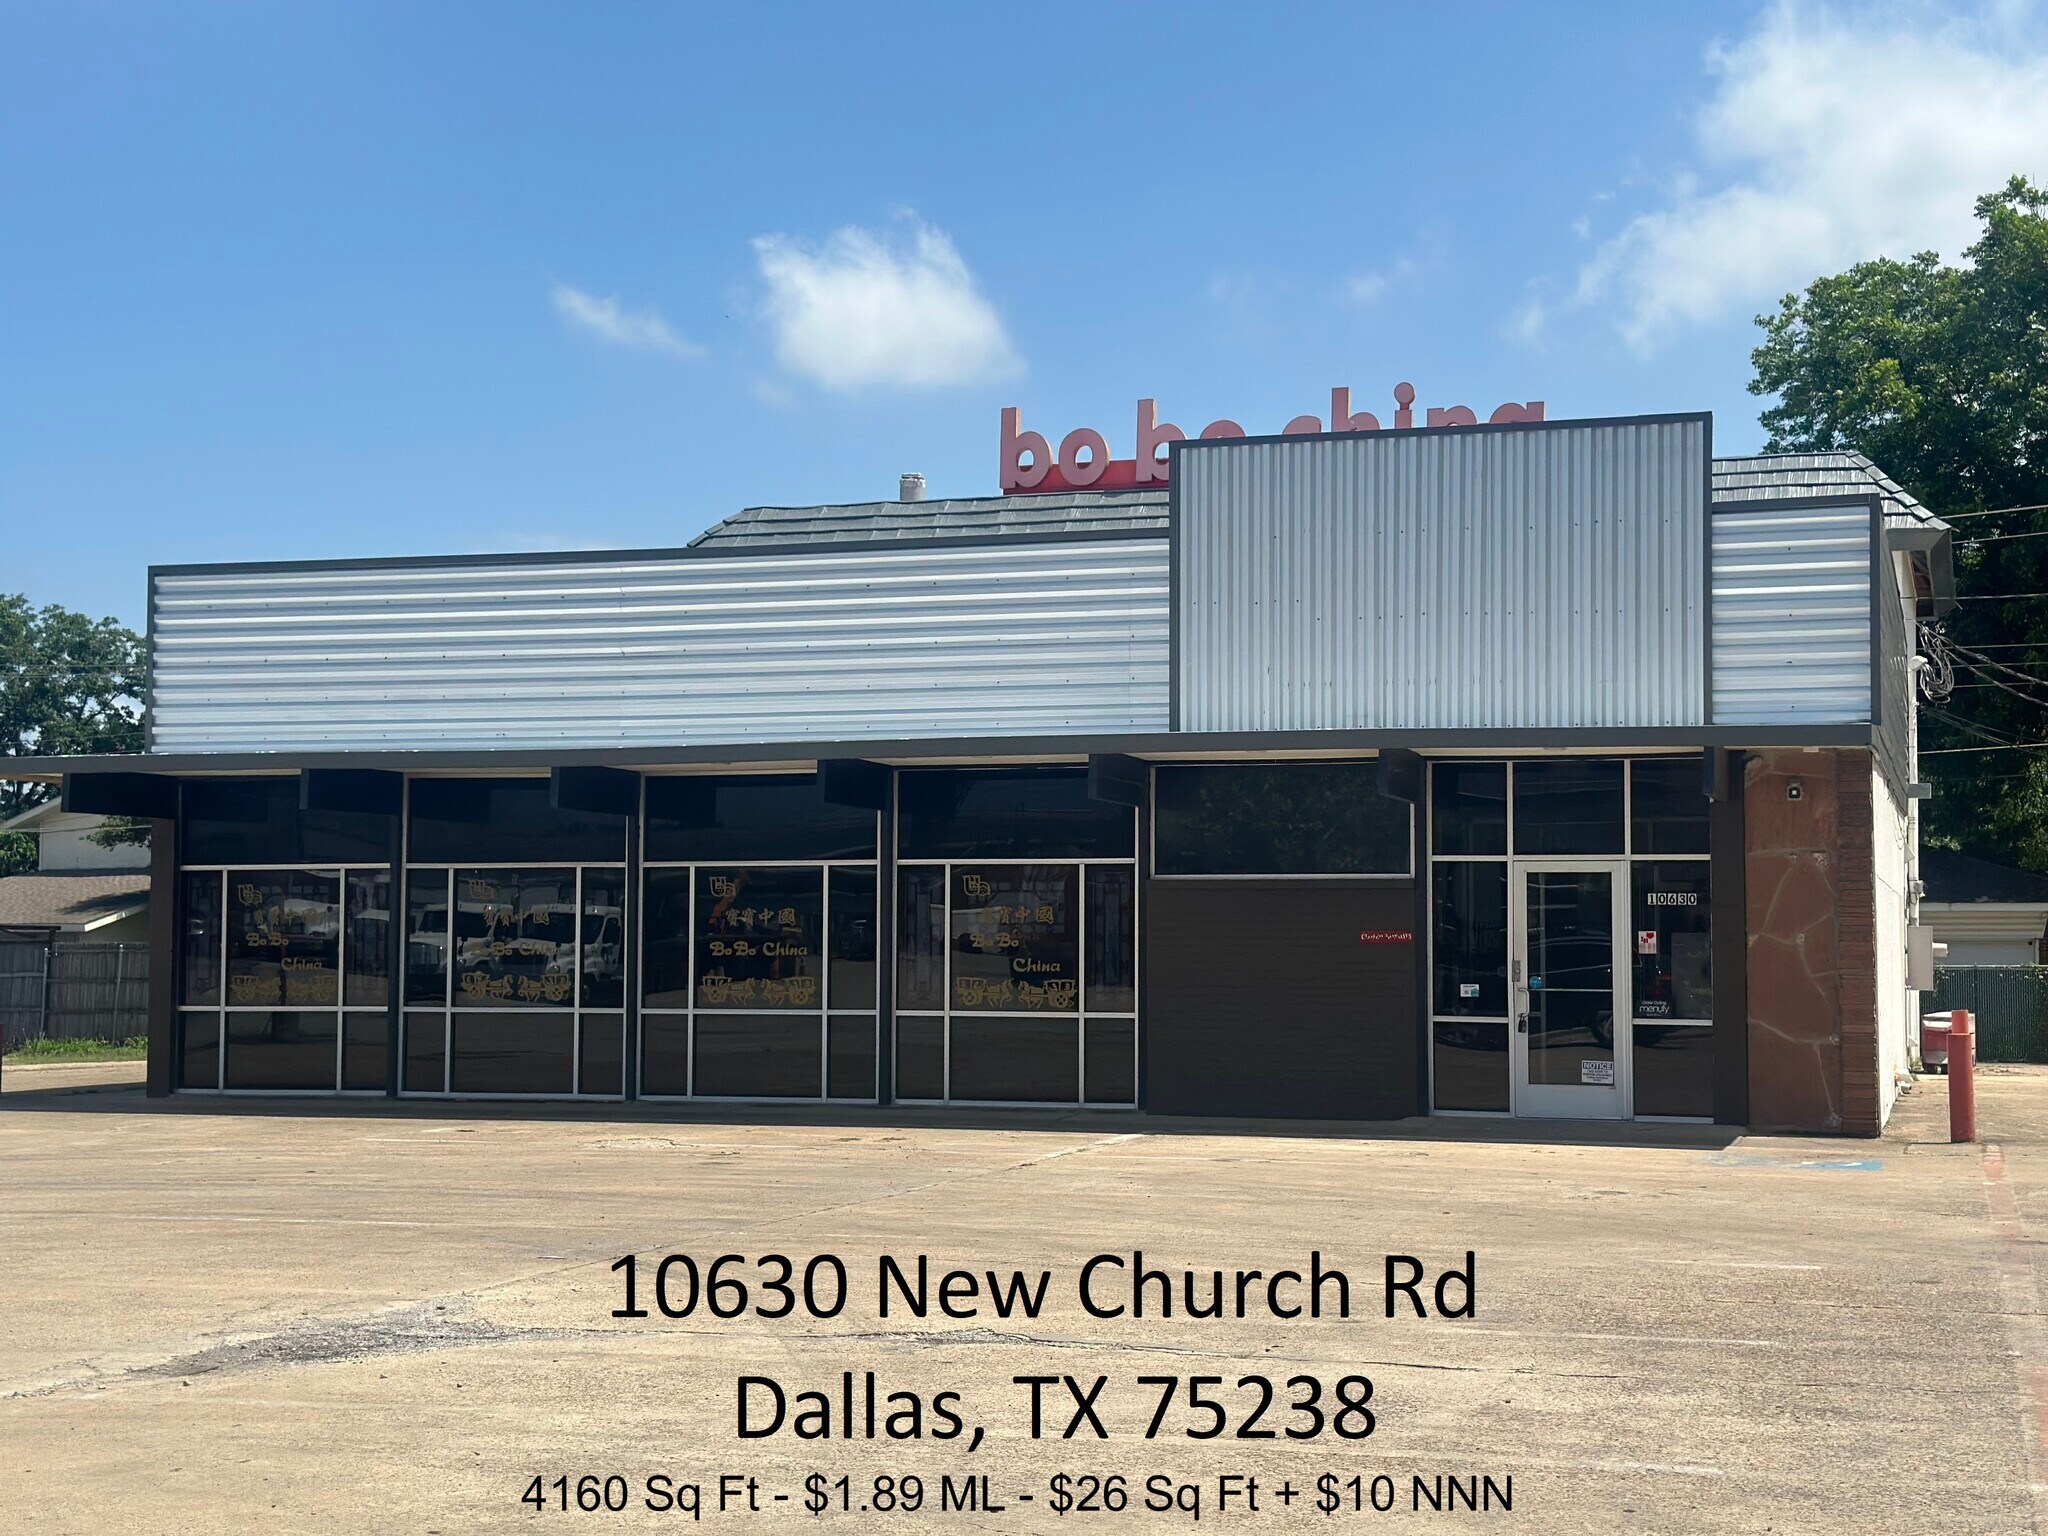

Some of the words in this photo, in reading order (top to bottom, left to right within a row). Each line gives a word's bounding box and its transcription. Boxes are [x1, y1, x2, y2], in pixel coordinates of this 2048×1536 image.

[1000, 406, 1110, 489] bo
[1648, 893, 1697, 905] 10630
[246, 932, 267, 947] Bo
[269, 932, 289, 947] Bo
[996, 932, 1020, 947] Bo
[709, 941, 732, 956] Bo
[733, 941, 757, 956] Bo
[763, 941, 808, 956] China
[281, 957, 322, 970] China
[1013, 957, 1061, 972] China
[1583, 1062, 1612, 1070] NOTICE
